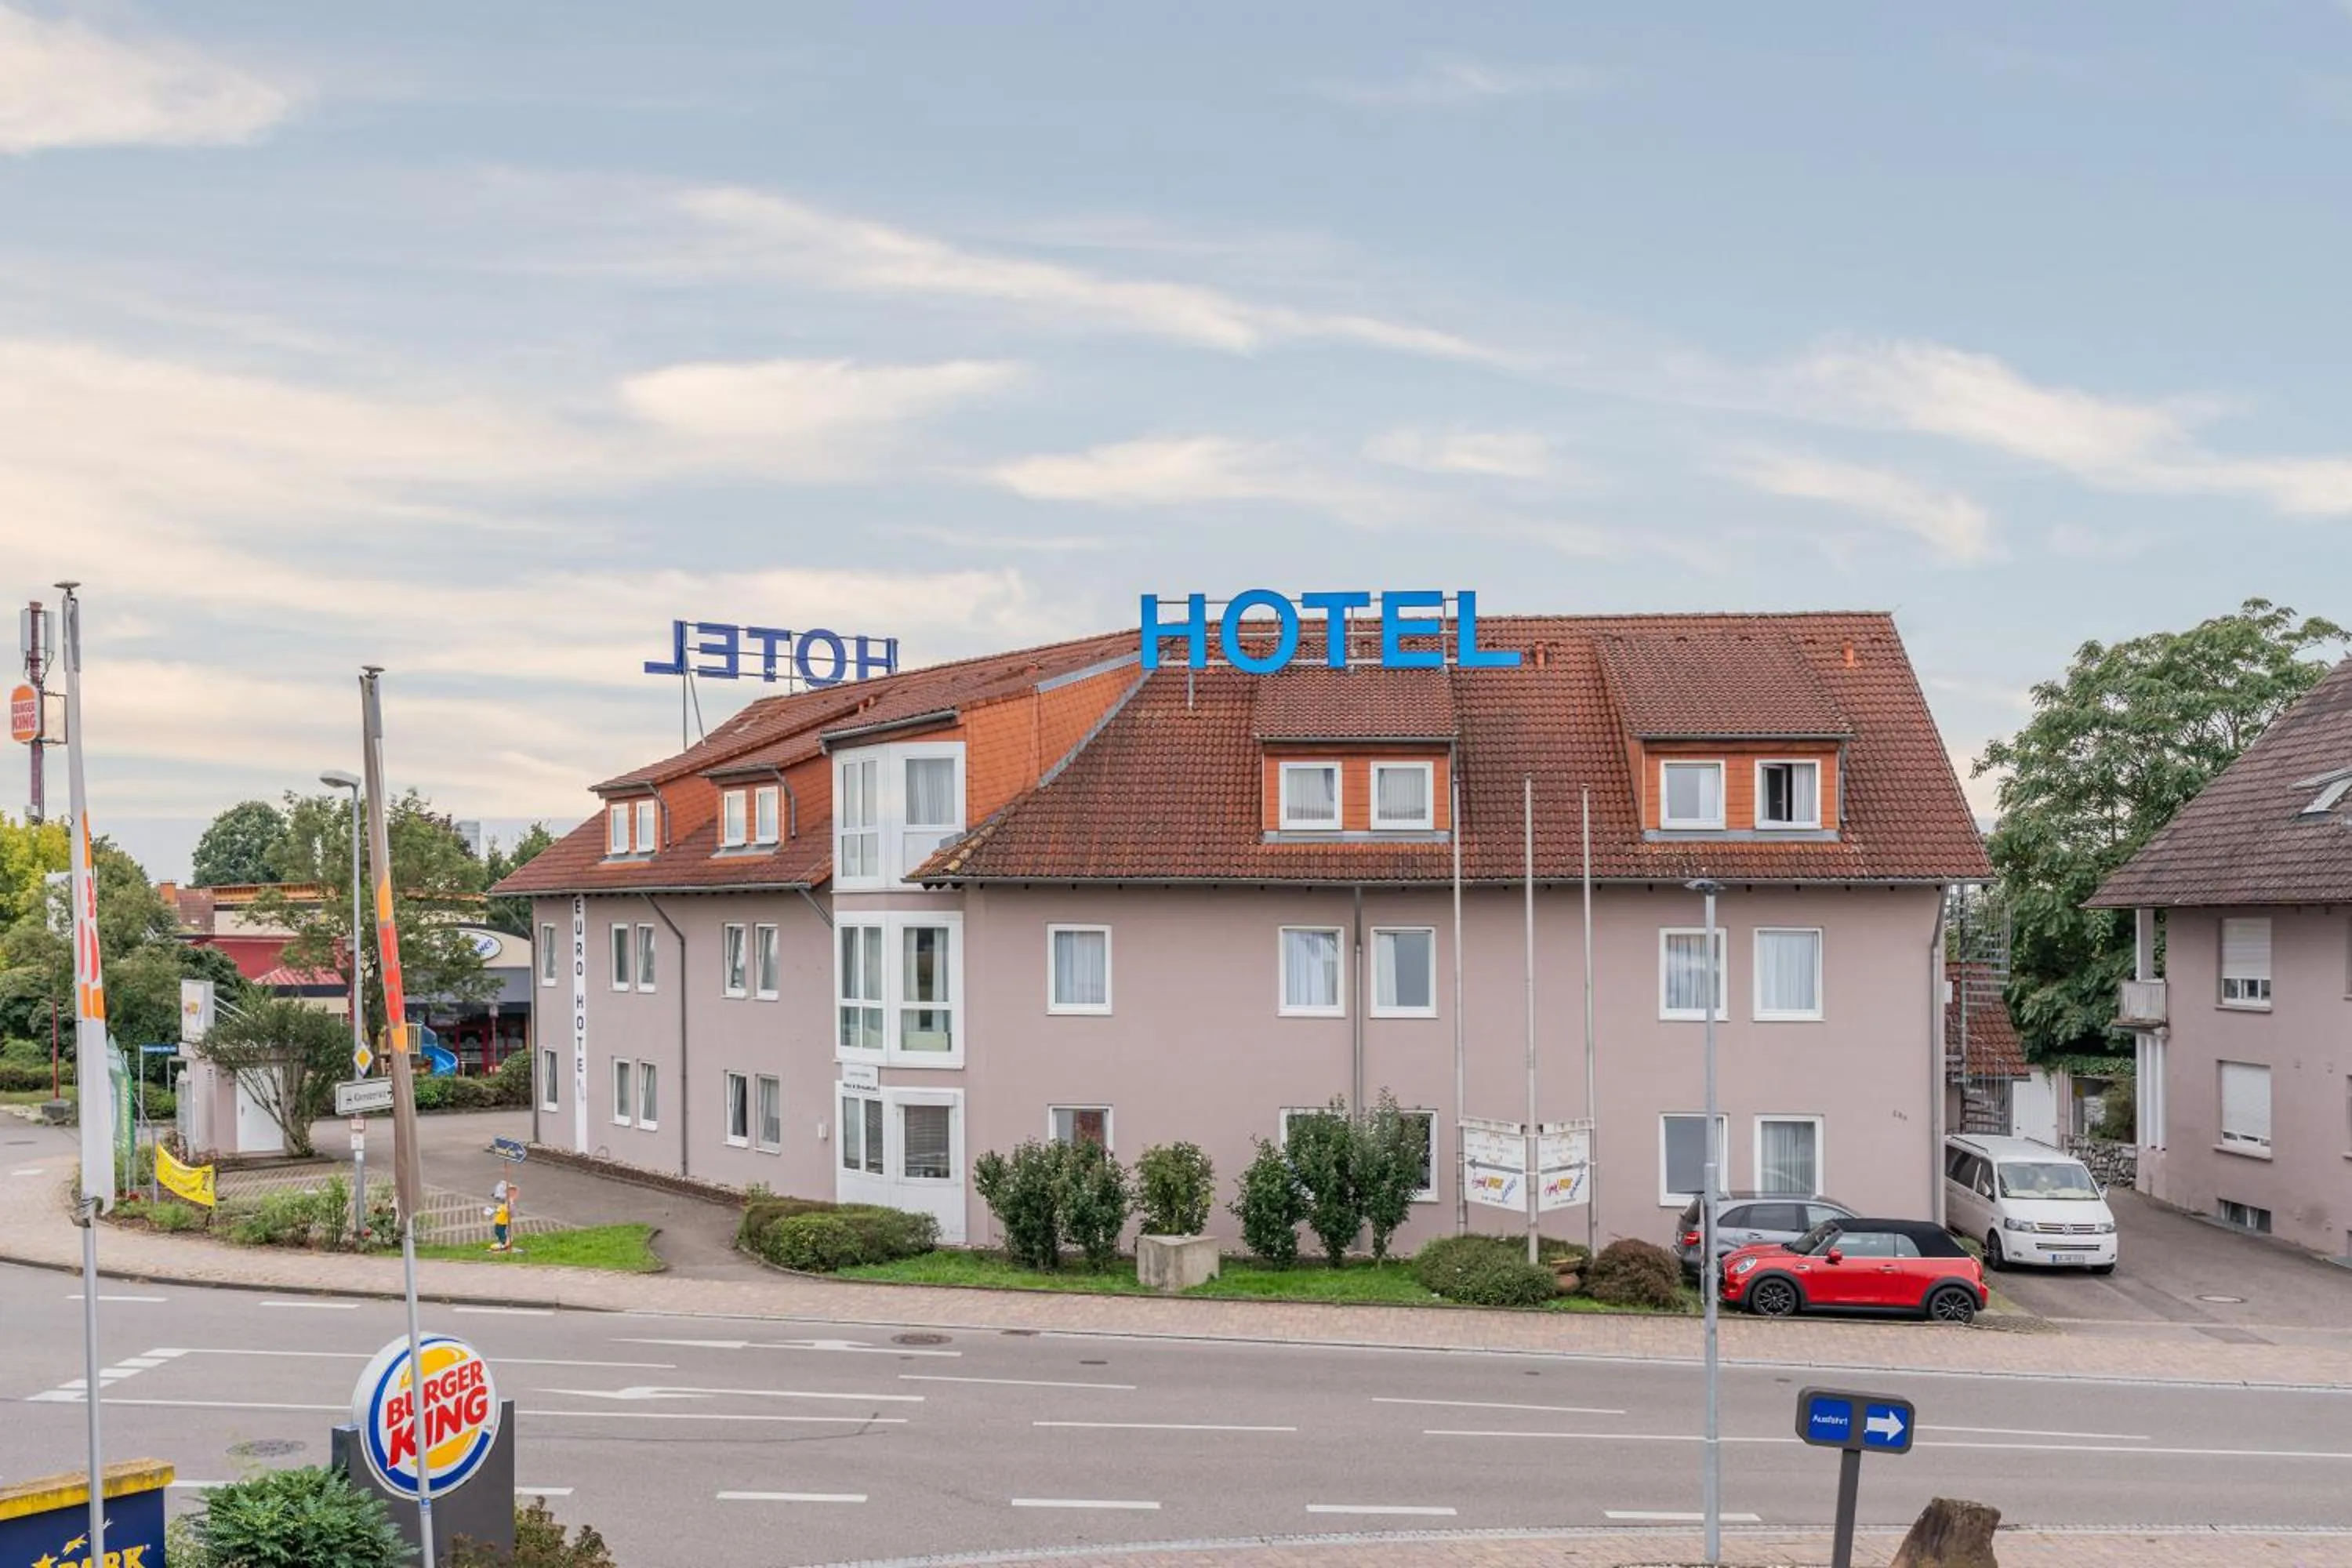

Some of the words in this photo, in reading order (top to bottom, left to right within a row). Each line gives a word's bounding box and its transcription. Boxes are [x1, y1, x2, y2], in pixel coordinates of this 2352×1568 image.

[1141, 589, 1521, 674] HOTEL
[12, 713, 36, 731] KING
[388, 1385, 488, 1468] KING
[57, 1545, 146, 1568] RK
